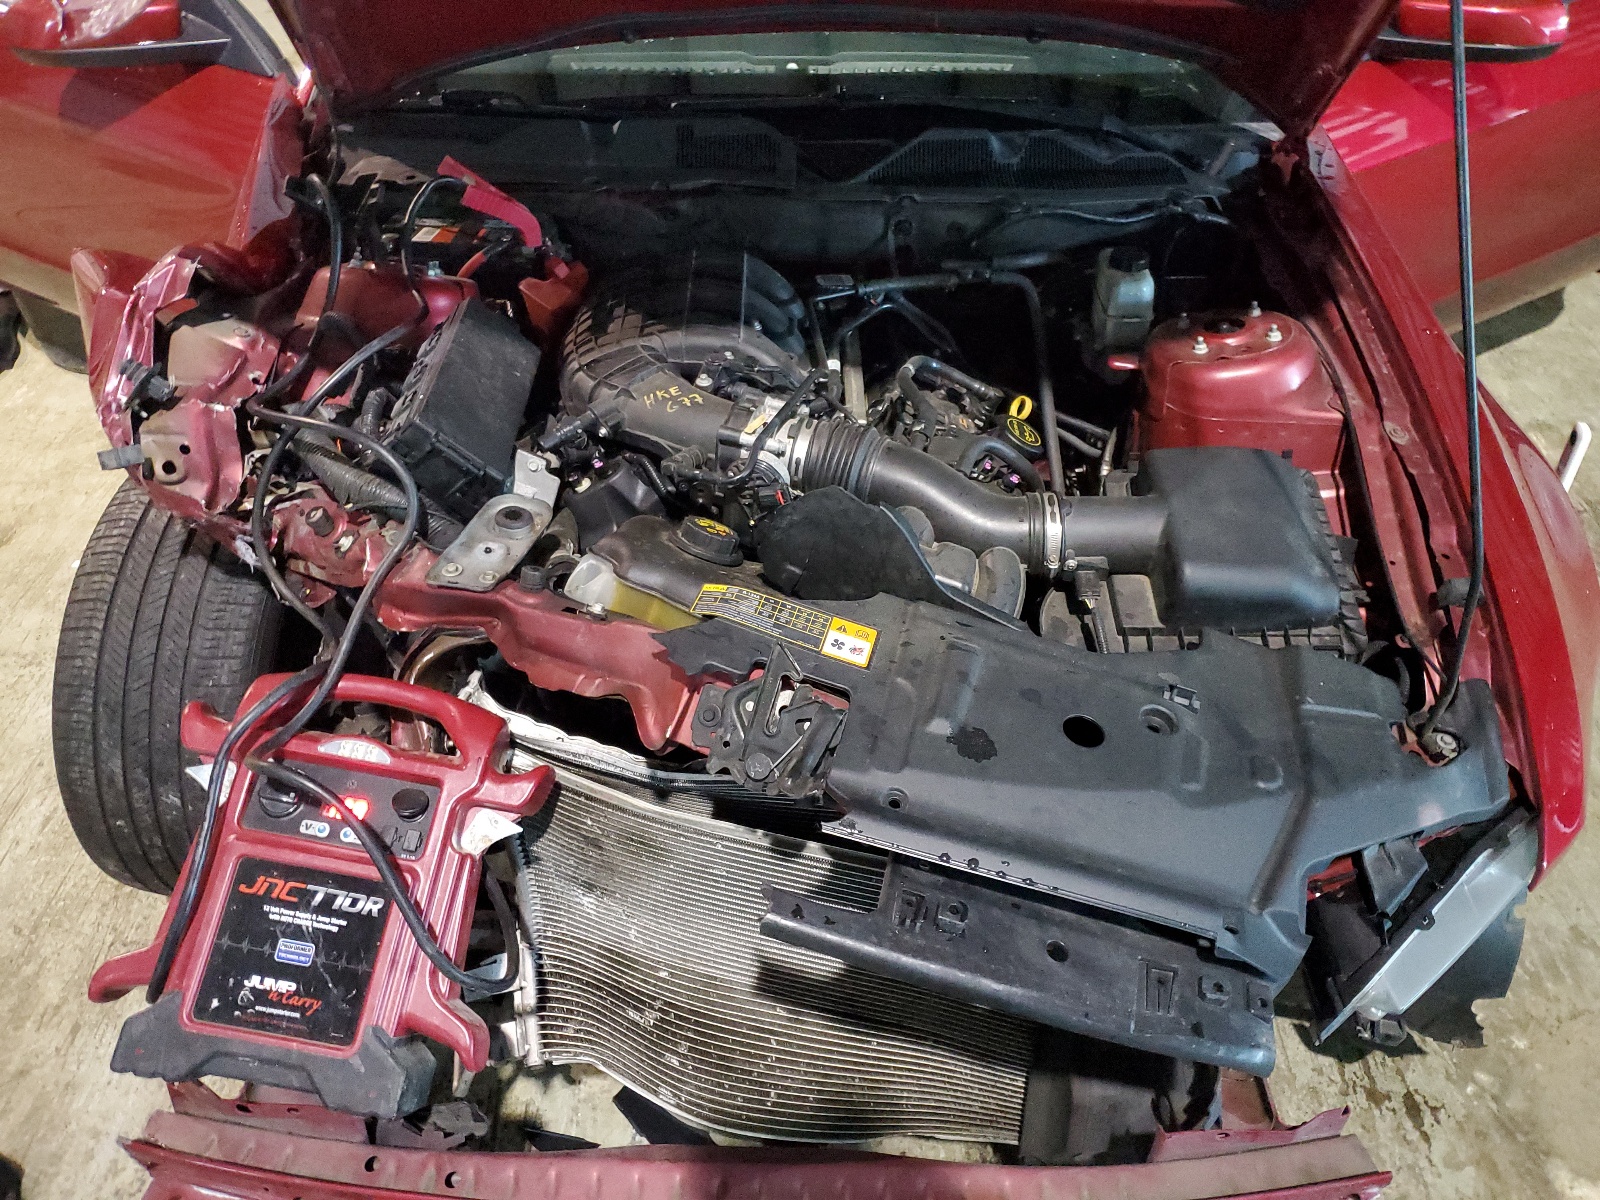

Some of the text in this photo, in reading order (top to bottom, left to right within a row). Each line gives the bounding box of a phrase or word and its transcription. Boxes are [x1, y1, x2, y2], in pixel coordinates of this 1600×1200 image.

[644, 385, 682, 409] HKE
[279, 907, 296, 916] Power
[243, 975, 297, 993] JUMP
